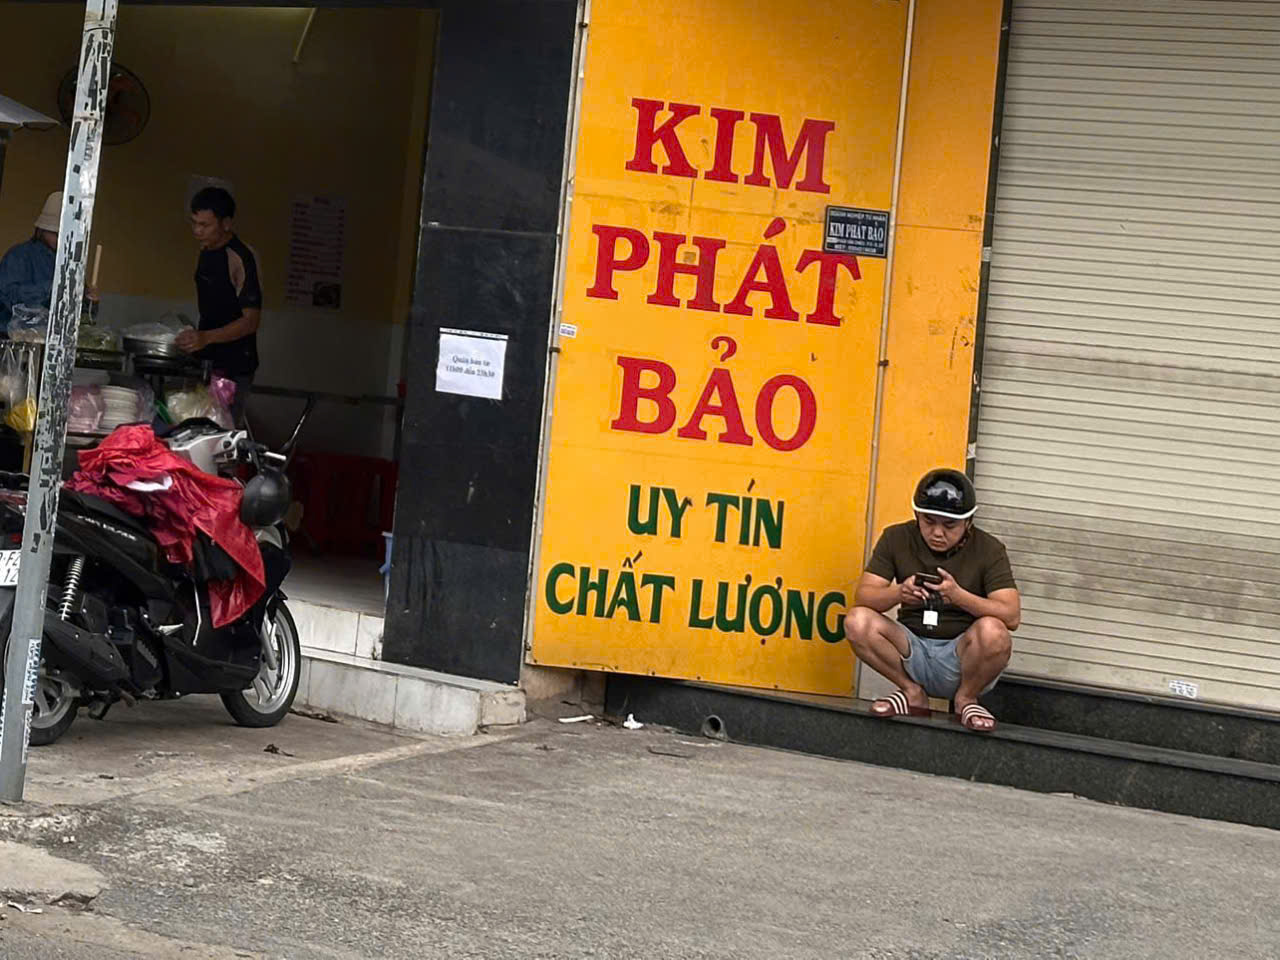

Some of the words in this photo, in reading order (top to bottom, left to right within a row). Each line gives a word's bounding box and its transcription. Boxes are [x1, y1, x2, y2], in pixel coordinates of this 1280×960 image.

[625, 97, 836, 195] KIM
[585, 216, 860, 327] PHÁT
[611, 335, 817, 453] BẢO
[627, 483, 693, 537] UY
[705, 478, 784, 549] TÍN
[545, 551, 673, 623] CHẤT
[687, 573, 847, 644] LƯỢNG
